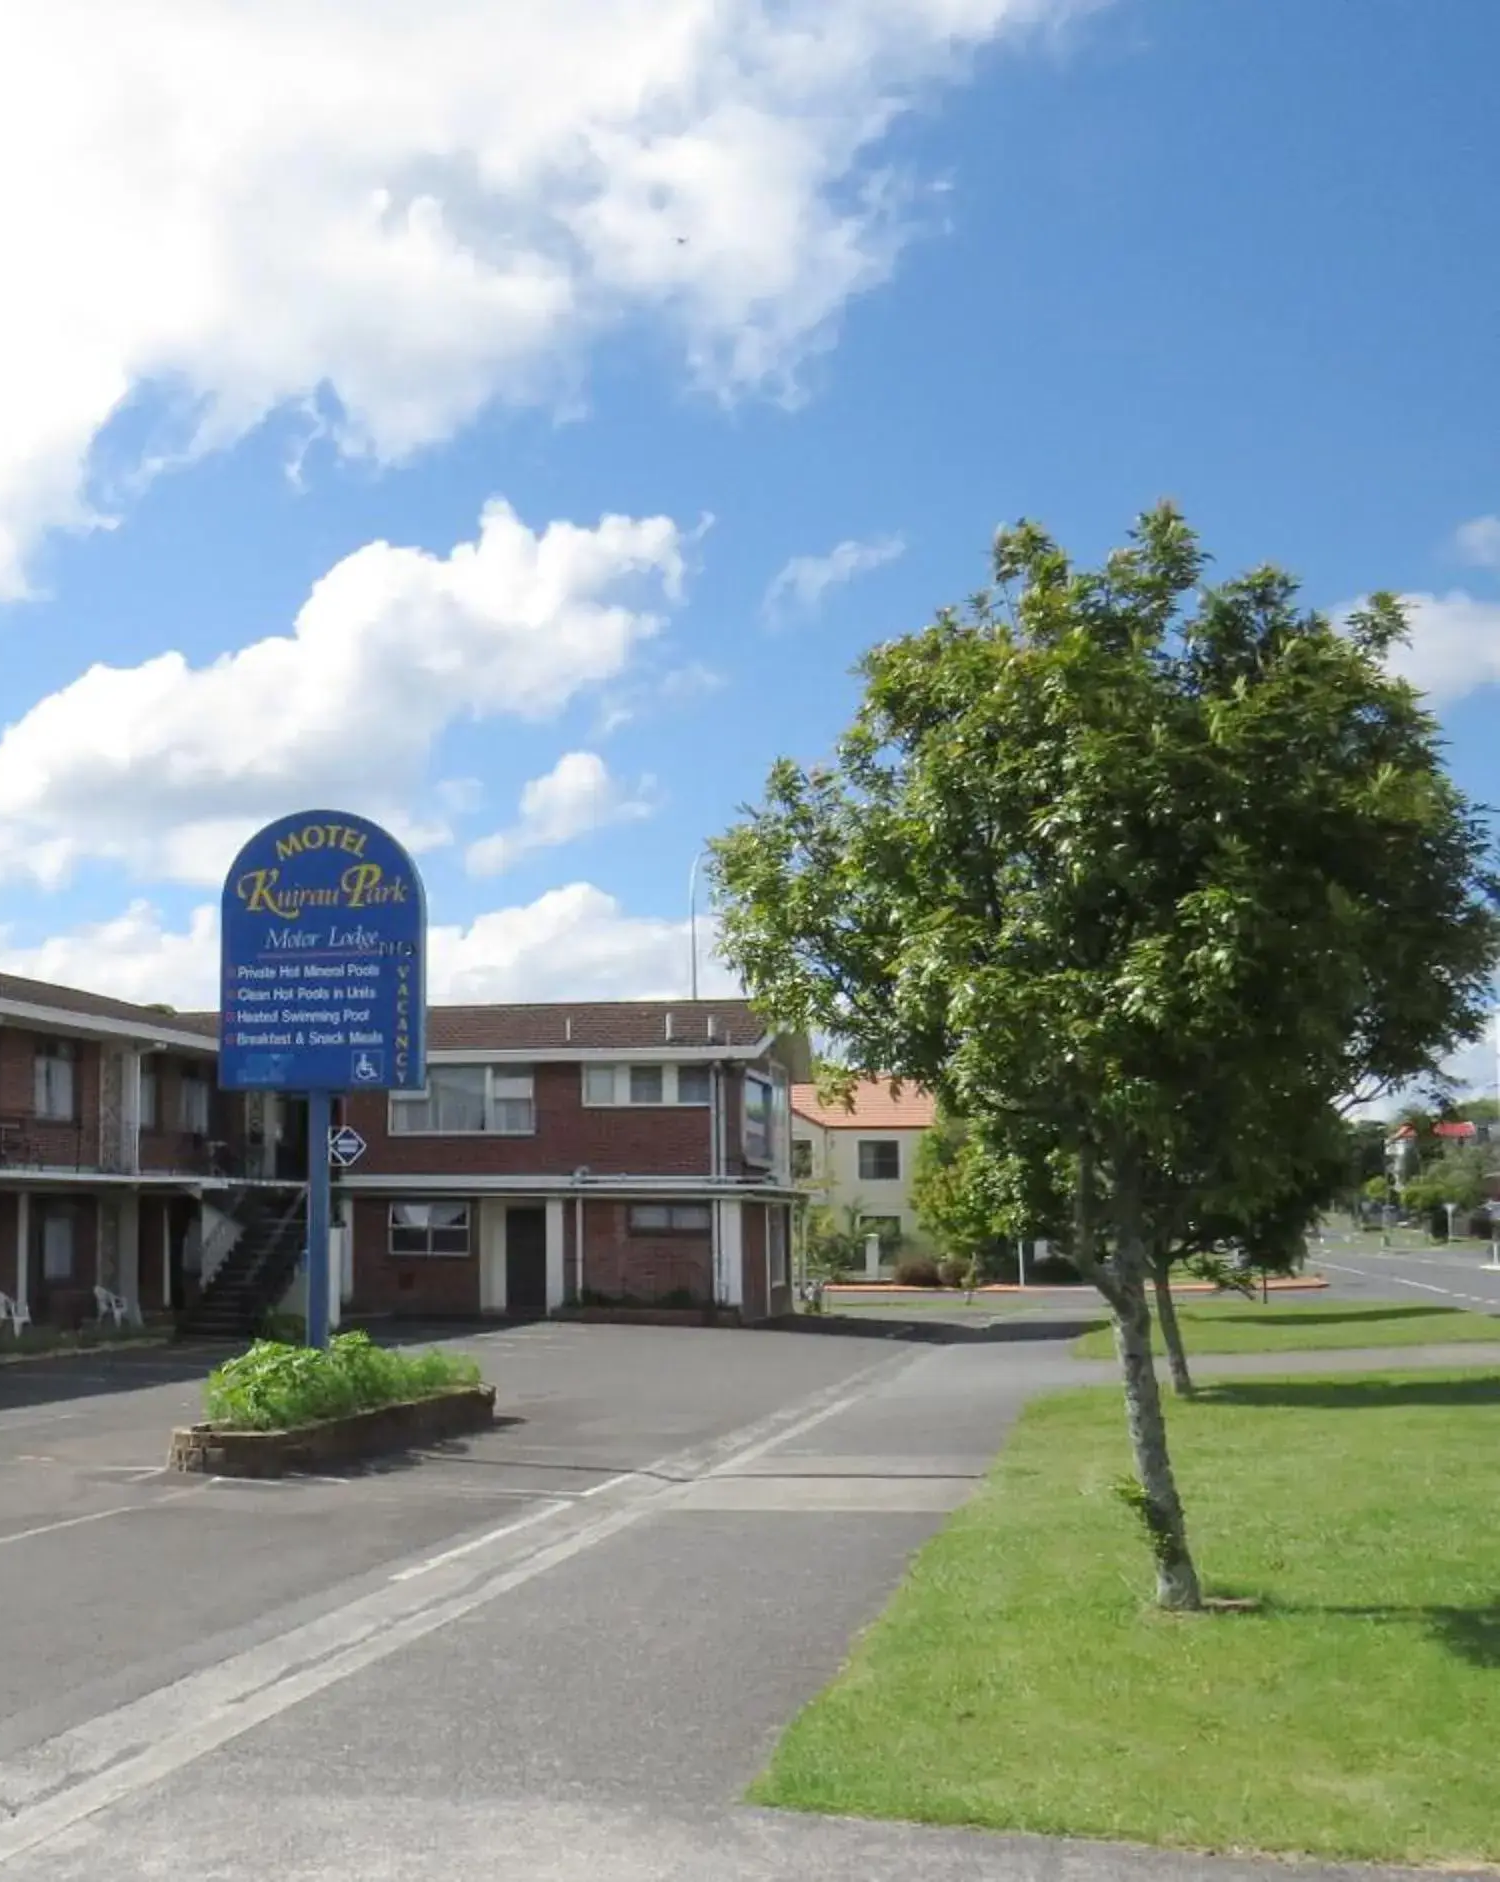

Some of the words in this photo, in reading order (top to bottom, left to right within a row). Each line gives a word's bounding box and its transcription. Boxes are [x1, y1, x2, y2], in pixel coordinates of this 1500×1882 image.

[276, 825, 367, 861] MOTEL
[237, 867, 339, 918] Kuirau
[341, 863, 408, 907] Park
[265, 927, 322, 950] Motor
[329, 924, 380, 951] Lodge
[237, 965, 277, 980] Private
[280, 965, 300, 979] Hot
[303, 965, 345, 978] Mineral
[347, 963, 380, 977] Pools
[237, 987, 271, 1001] Clean
[273, 987, 293, 1001] Hot
[297, 986, 329, 1000] Pools
[333, 986, 345, 999] in
[347, 984, 376, 999] Units
[237, 1009, 279, 1023] Heated
[281, 1008, 340, 1024] Swimming
[343, 1007, 370, 1022] Pool
[396, 963, 409, 1084] VACANCY
[237, 1031, 291, 1045] Breakfast
[295, 1031, 305, 1045] &
[308, 1030, 345, 1045] Snack
[349, 1029, 384, 1044] Meals
